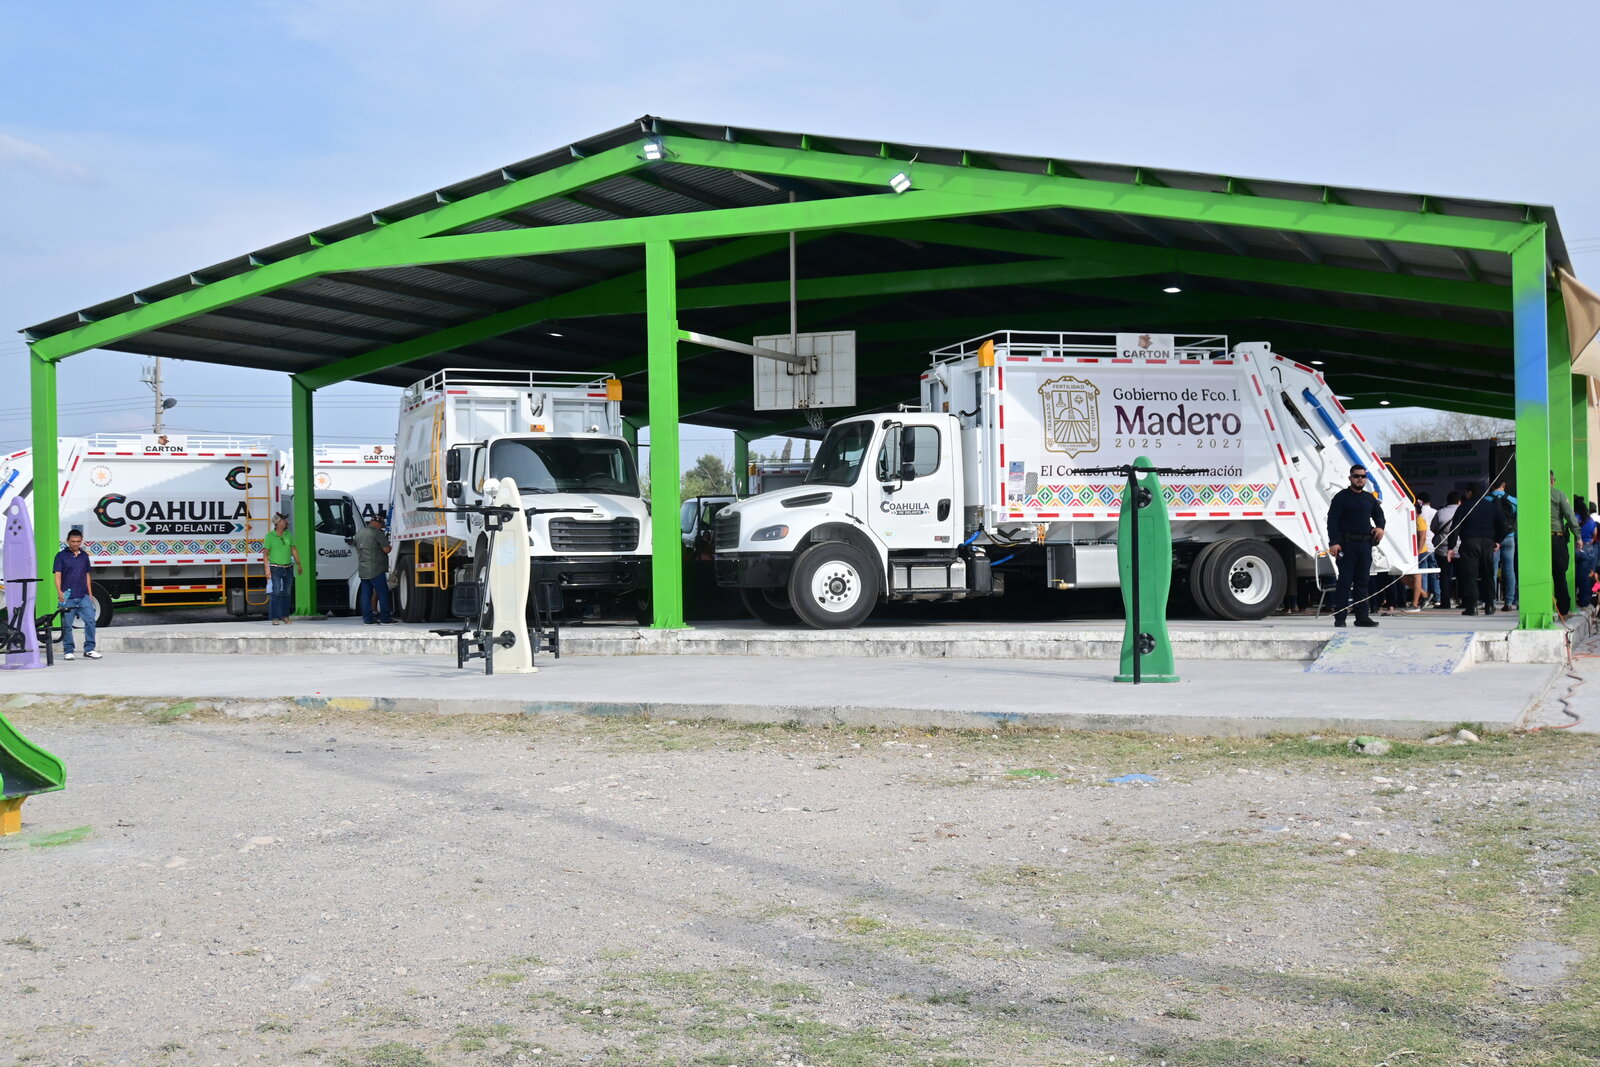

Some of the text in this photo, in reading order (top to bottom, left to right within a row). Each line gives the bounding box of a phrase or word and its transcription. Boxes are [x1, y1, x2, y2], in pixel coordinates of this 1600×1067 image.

[1123, 350, 1170, 358] CARTON
[1113, 388, 1241, 401] Gobierno de Fco. I.
[1114, 403, 1241, 435] Madero
[1115, 438, 1162, 448] 2025
[1197, 438, 1242, 448] 2027
[1040, 465, 1053, 477] El
[94, 493, 252, 528] COAHUILA
[880, 500, 930, 513] COAHUILA
[175, 523, 226, 533] DELANTE
